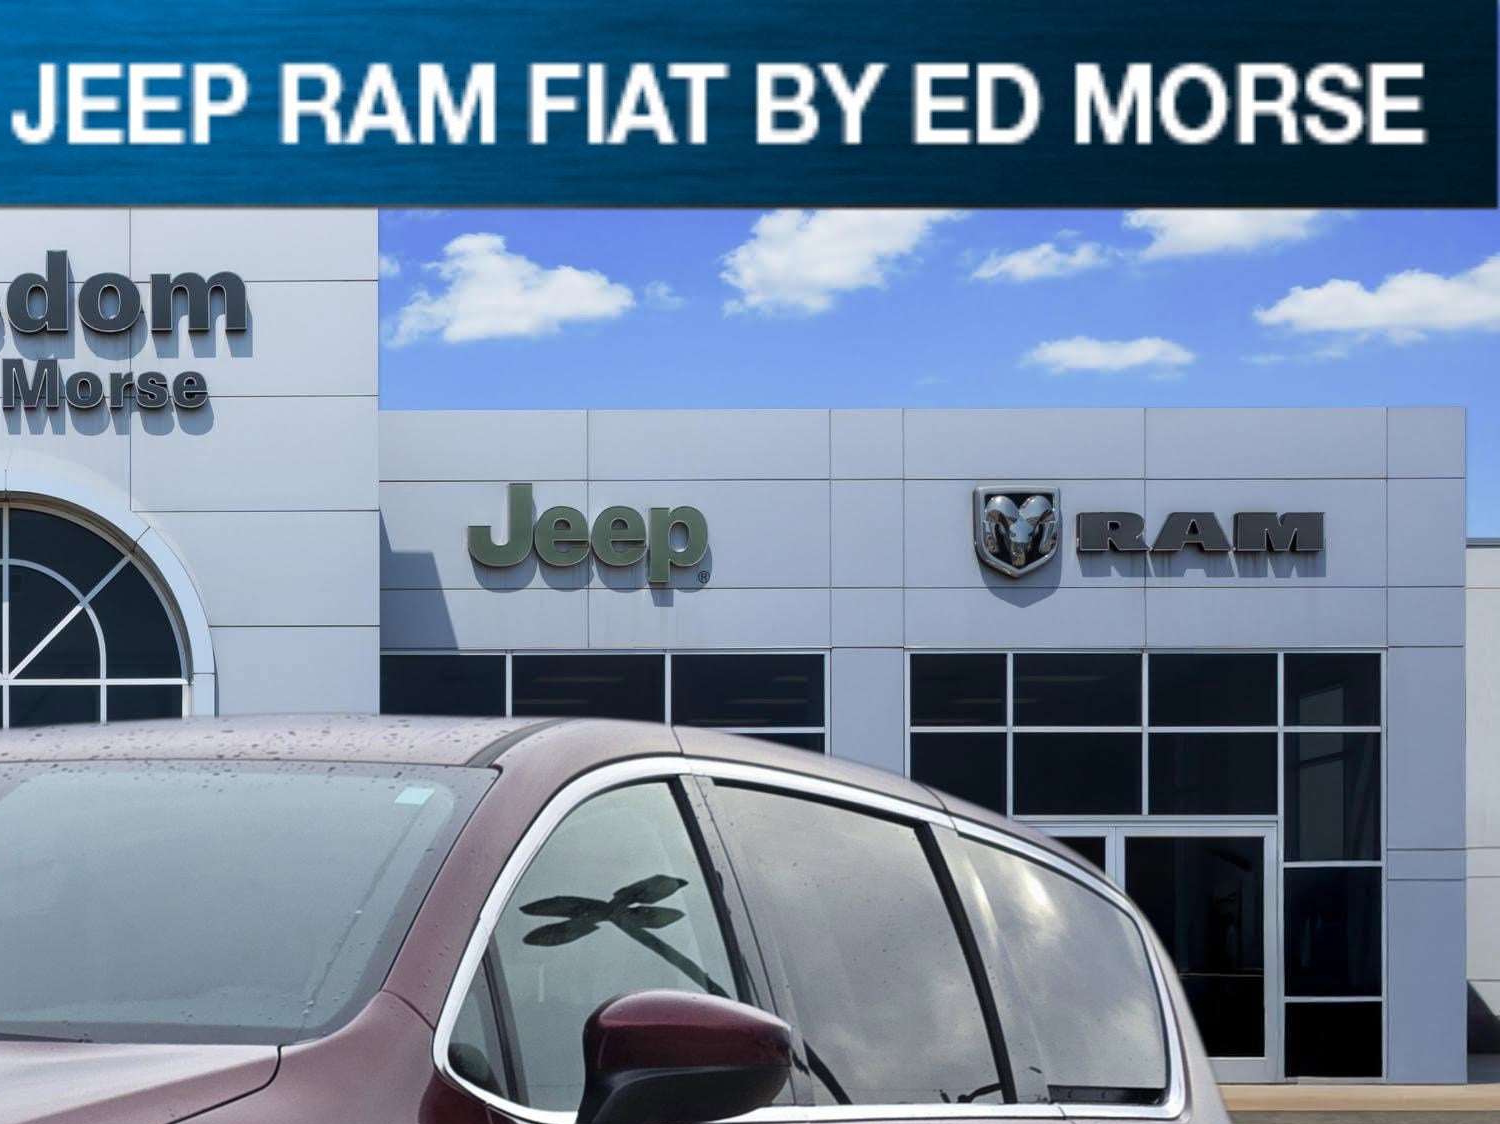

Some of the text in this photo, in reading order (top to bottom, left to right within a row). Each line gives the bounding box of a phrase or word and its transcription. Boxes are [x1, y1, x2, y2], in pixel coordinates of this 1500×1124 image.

[1, 358, 208, 409] Morse
[467, 482, 709, 583] Jeep
[1076, 511, 1325, 552] RAM
